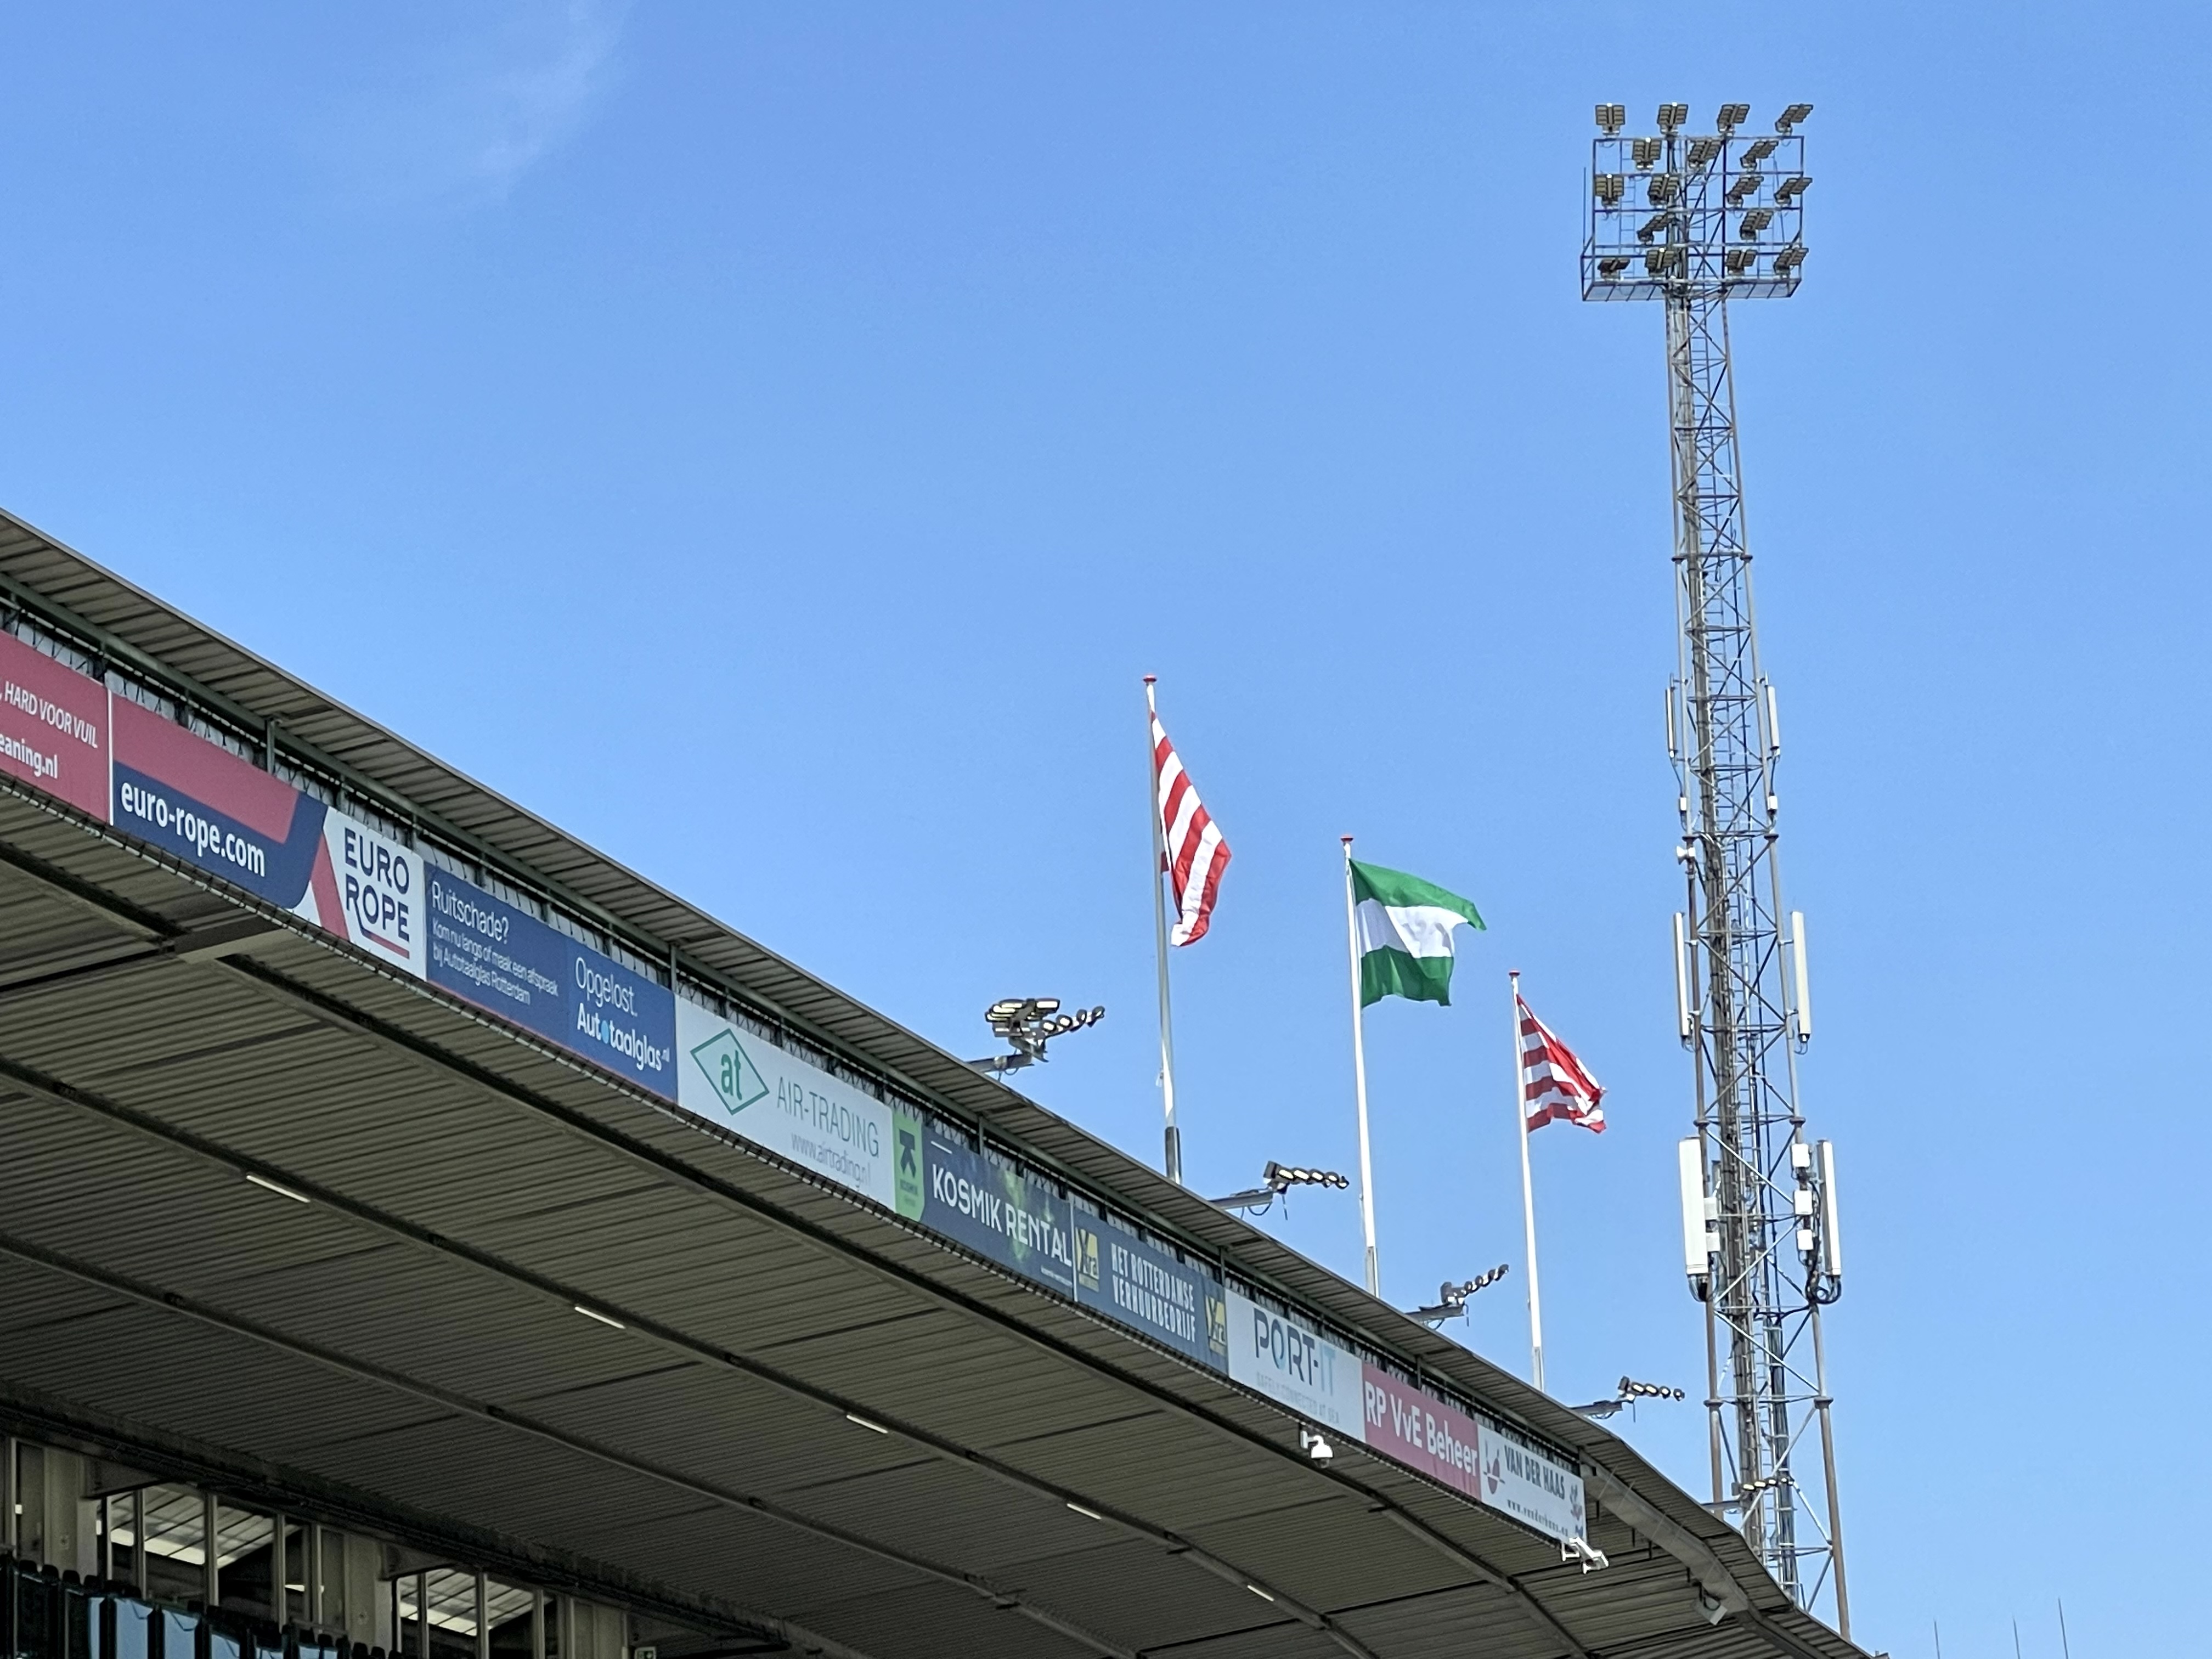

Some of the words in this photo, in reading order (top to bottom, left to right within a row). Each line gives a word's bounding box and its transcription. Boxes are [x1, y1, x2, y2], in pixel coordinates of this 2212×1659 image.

[4, 681, 38, 715] HARD
[40, 698, 71, 735] VOOR
[74, 716, 98, 748] VUIL
[121, 782, 265, 877] euro-rope.com
[345, 827, 409, 894] EURO
[346, 873, 410, 943] ROPE
[432, 881, 509, 945] Ruitschade?
[432, 917, 450, 941] Kom
[451, 930, 461, 948] nu
[576, 957, 637, 1017] Opgelost.
[721, 1050, 742, 1101] at
[777, 1076, 879, 1158] AIR-TRADING
[791, 1133, 871, 1188] www.airtrading.nl
[933, 1164, 1002, 1233] KOSMIK
[1005, 1203, 1071, 1267] RENTAL
[1111, 1242, 1128, 1277] HET
[1131, 1254, 1194, 1312] ROTTERDAMSE
[1113, 1275, 1195, 1343] VERHUURBEDRIJF
[1365, 1381, 1386, 1427] RP
[1390, 1393, 1423, 1448] VvE
[1426, 1412, 1477, 1476] Beheer
[1504, 1444, 1523, 1478] VAN
[1525, 1455, 1542, 1488] DER
[1543, 1465, 1565, 1500] HAAS
